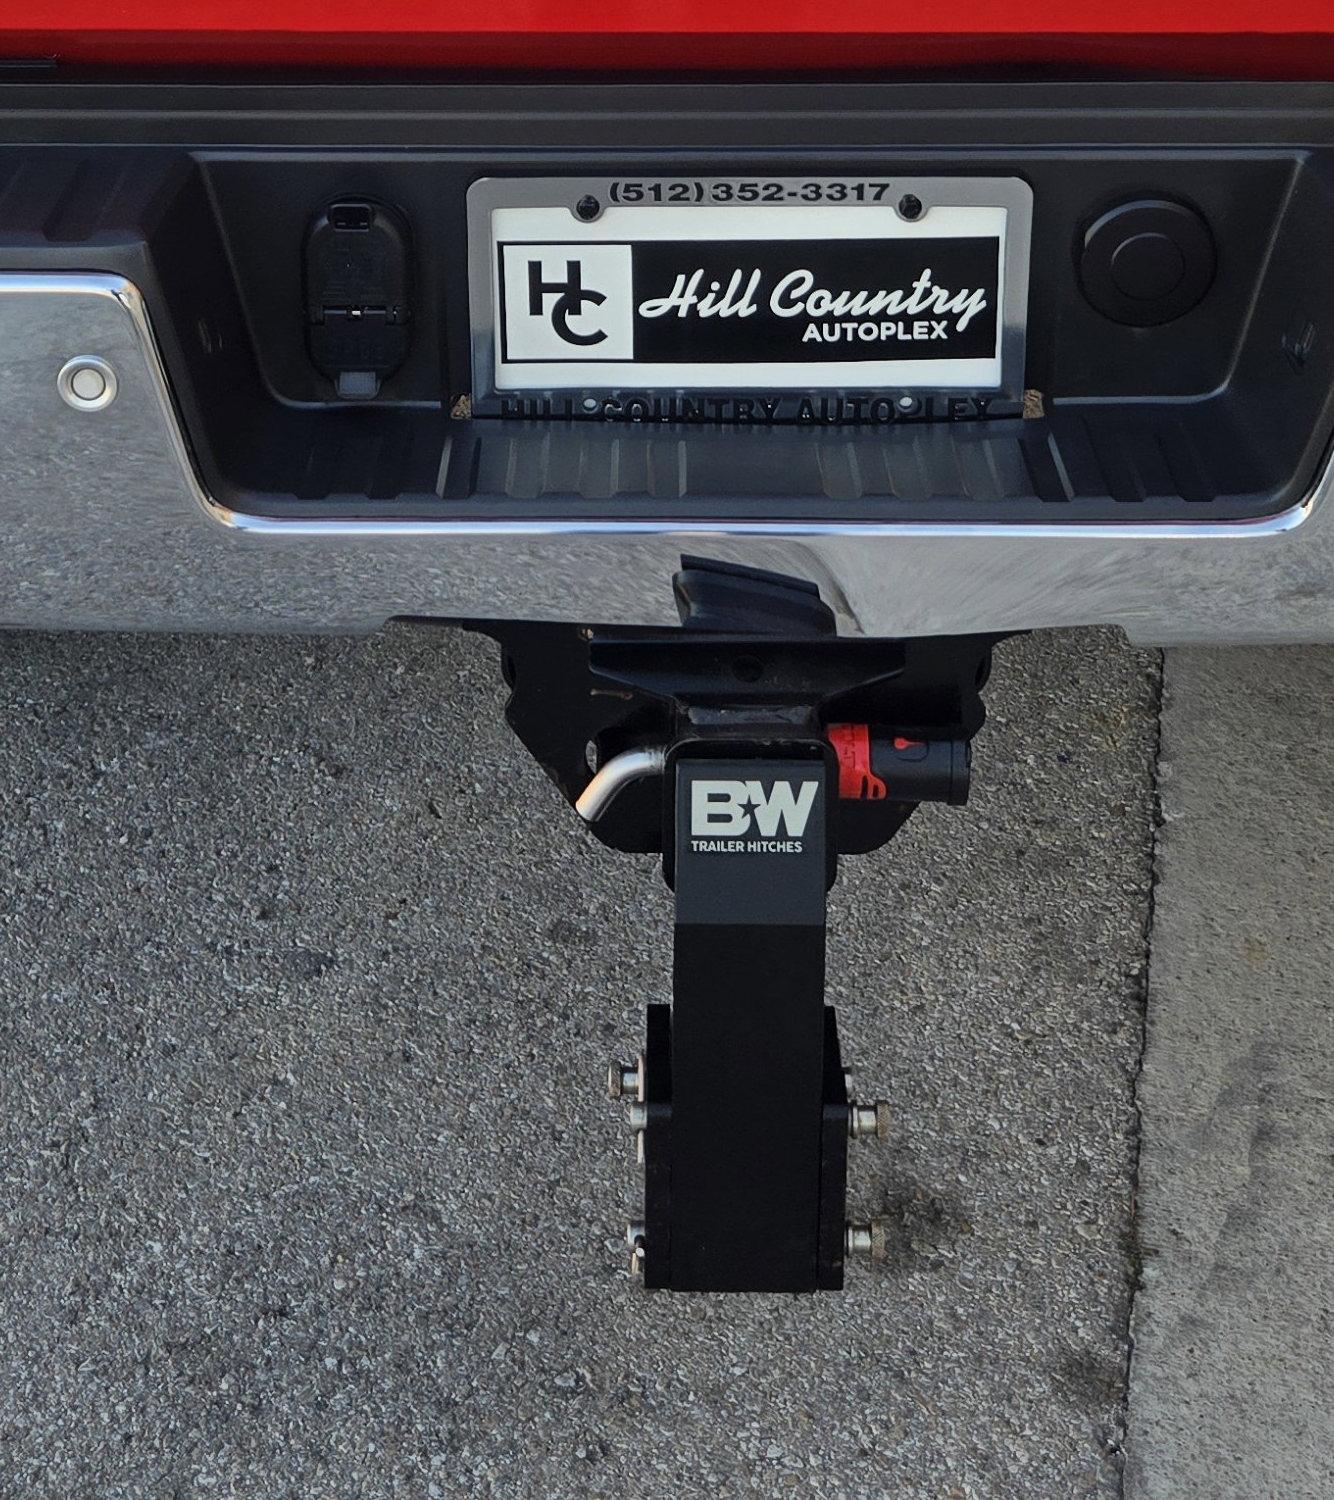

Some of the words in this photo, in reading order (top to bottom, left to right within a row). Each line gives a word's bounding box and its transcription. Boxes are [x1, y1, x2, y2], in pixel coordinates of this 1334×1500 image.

[638, 268, 762, 318] Hill
[769, 267, 988, 332] Country
[801, 320, 949, 343] AUTOPLEX
[691, 840, 745, 853] TRAILER
[747, 840, 803, 854] HITCHES
